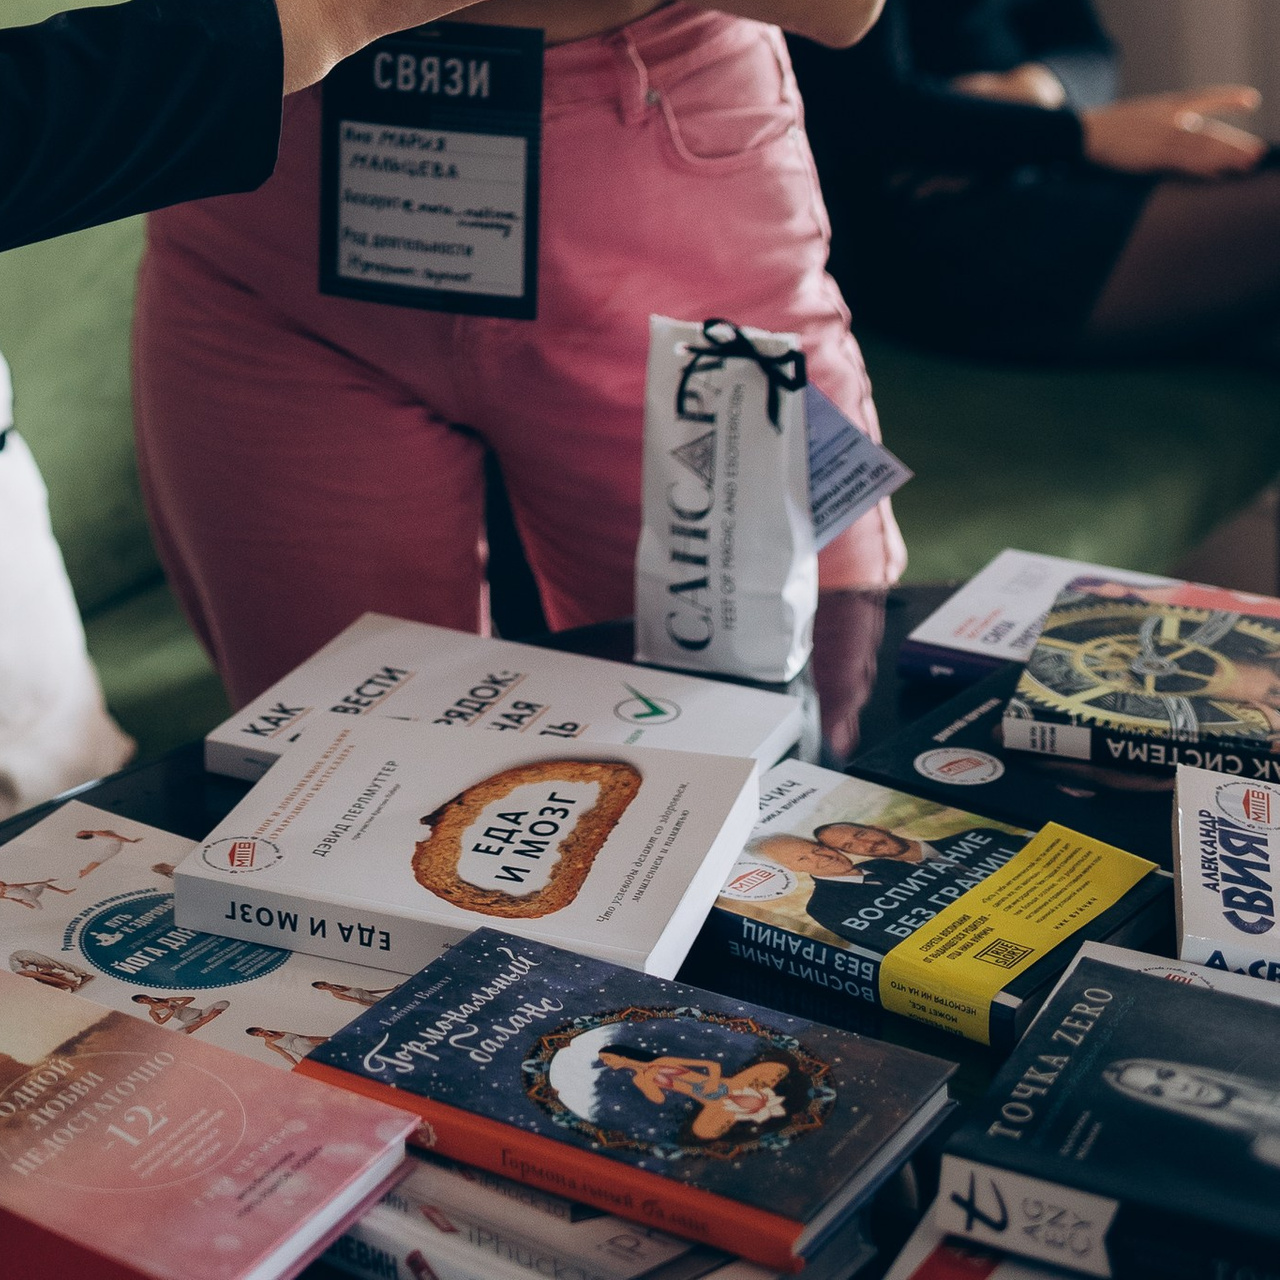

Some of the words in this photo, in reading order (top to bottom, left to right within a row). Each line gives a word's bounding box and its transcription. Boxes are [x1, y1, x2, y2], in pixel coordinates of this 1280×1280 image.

[373, 51, 489, 98] СВЯЗИ
[242, 701, 306, 737] КАК
[1106, 738, 1243, 775] СИСТЕМА
[311, 822, 351, 856] ДЭВИД
[339, 759, 400, 820] ПЕРЛМУТТЕР
[512, 791, 577, 860] МОЗГ
[472, 811, 529, 856] ЕДА
[1198, 809, 1222, 894] АЛЕКСАНДР
[494, 865, 531, 883] И
[596, 903, 616, 926] Что
[609, 866, 640, 906] углеводы
[631, 834, 658, 869] делают
[841, 831, 992, 932] ВОСПИТАНИЕ
[884, 902, 937, 939] БЕЗ
[928, 848, 1019, 914] ГРАНИЦ
[104, 911, 133, 928] ПУТЬ
[224, 901, 299, 933] МОЗГ
[309, 916, 327, 939] И
[1052, 918, 1070, 930] НИК
[336, 921, 391, 952] ЕДА
[741, 916, 824, 960] ГРАНИЦ
[985, 942, 1013, 958] TRUE
[110, 939, 162, 976] ЙОГА
[729, 940, 875, 1004] ВОСПИТАНИЕ
[834, 952, 875, 981] БЕЗ
[890, 980, 905, 991] ЧТО
[907, 986, 918, 995] НА
[921, 990, 931, 999] НИ
[363, 946, 542, 1073] Гормональный
[908, 1000, 925, 1012] ВСЕ,
[929, 1007, 957, 1023] МОЖЕТ
[934, 994, 976, 1015] НЕСМОТРЯ
[448, 996, 564, 1063] баланс
[986, 1054, 1070, 1140] ТОЧКА
[1051, 987, 1114, 1046] ZERO
[10, 1050, 175, 1176] НЕДОСТАТОЧНО
[29, 1070, 105, 1130] ЛЮБВИ
